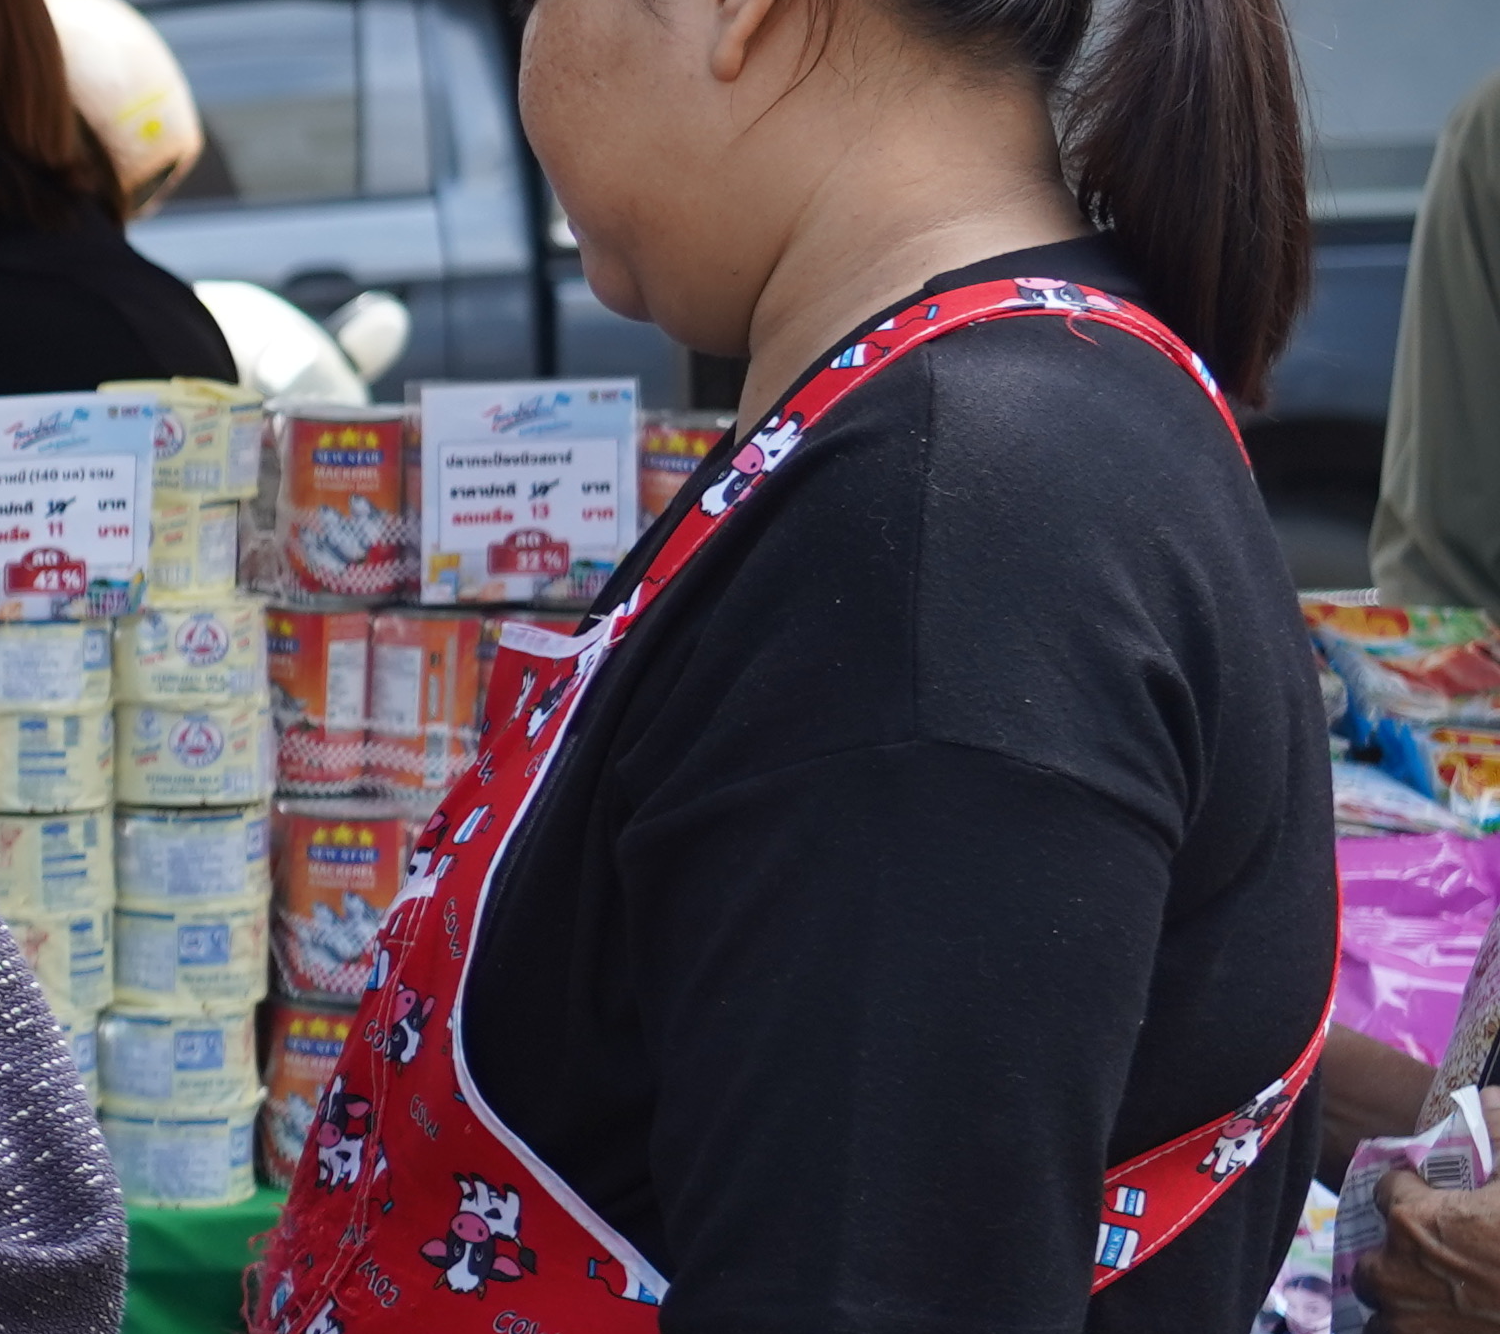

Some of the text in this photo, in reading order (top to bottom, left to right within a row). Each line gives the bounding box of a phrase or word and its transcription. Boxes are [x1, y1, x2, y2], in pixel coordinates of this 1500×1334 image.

[581, 481, 612, 496] บาท
[97, 497, 127, 511] บาท
[581, 507, 615, 522] บาท
[48, 521, 64, 537] 11
[97, 524, 130, 539] บาท
[33, 569, 59, 590] 42
